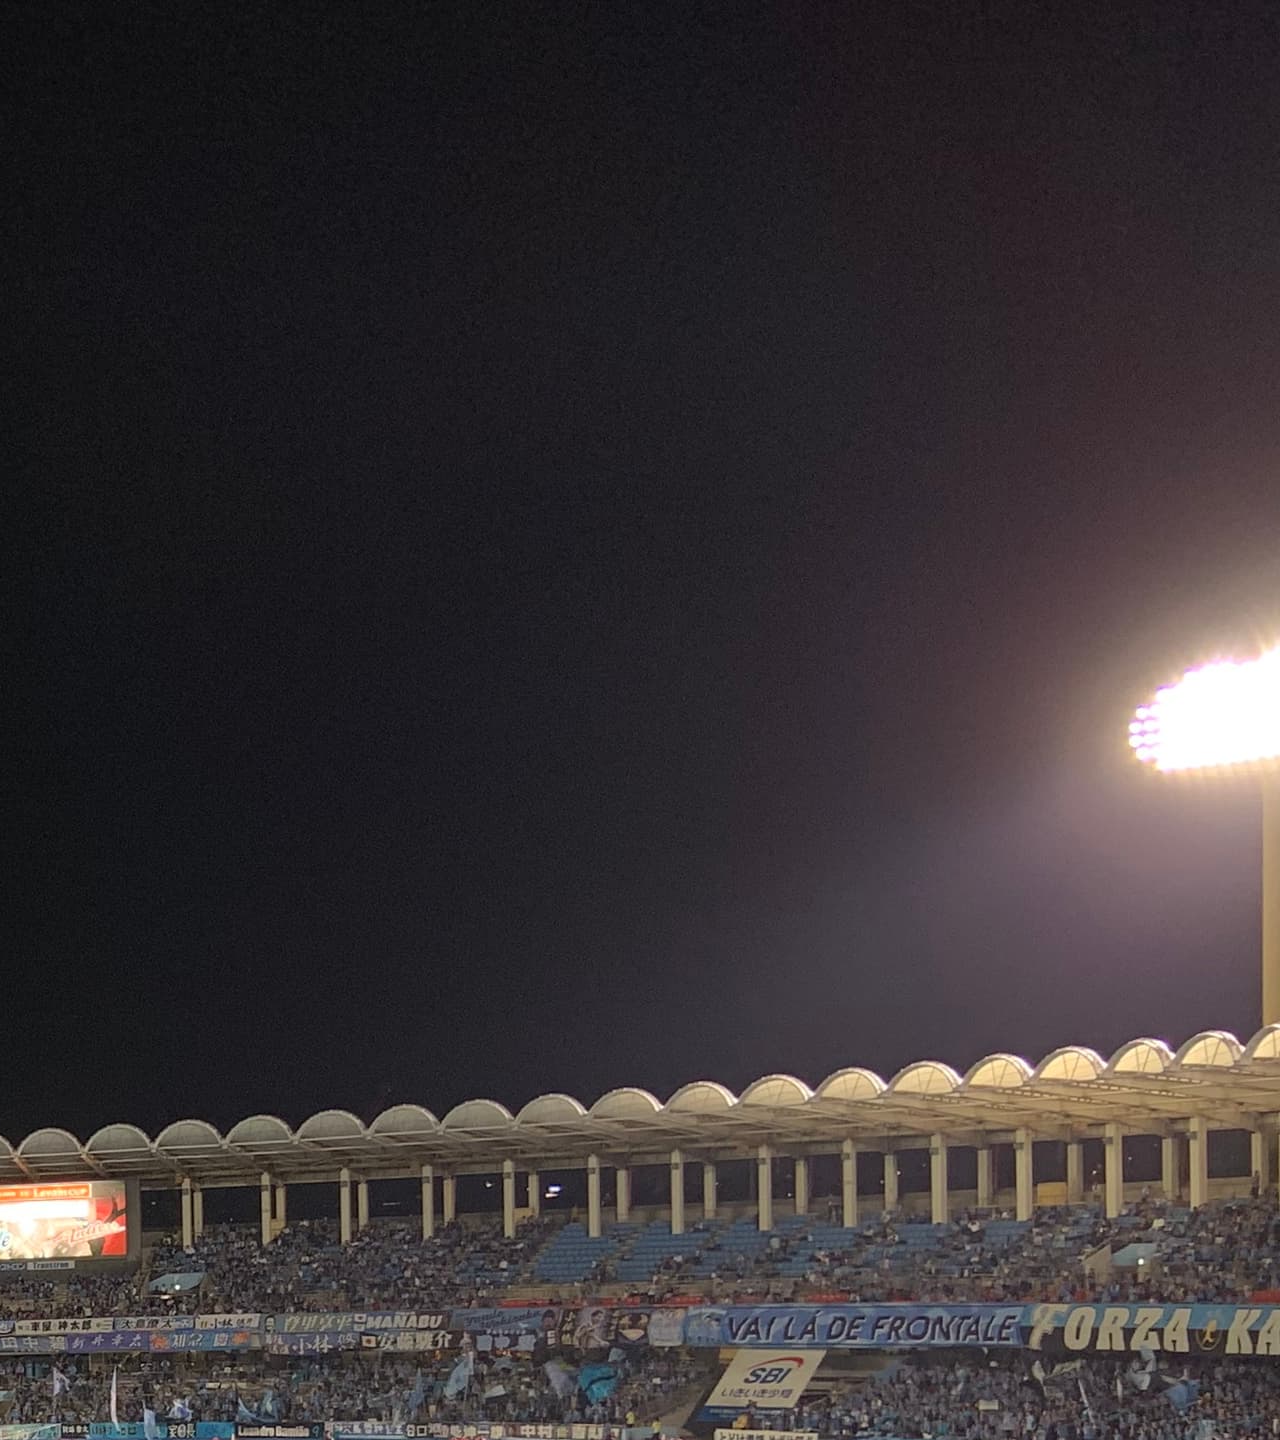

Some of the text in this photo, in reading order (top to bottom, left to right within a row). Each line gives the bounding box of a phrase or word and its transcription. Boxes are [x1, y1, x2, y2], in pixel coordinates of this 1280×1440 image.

[366, 1313, 443, 1330] MANABU
[827, 1314, 865, 1342] DE
[870, 1313, 1017, 1343] FRONTALE
[1029, 1304, 1192, 1352] FORZA
[744, 1367, 792, 1384] SBI
